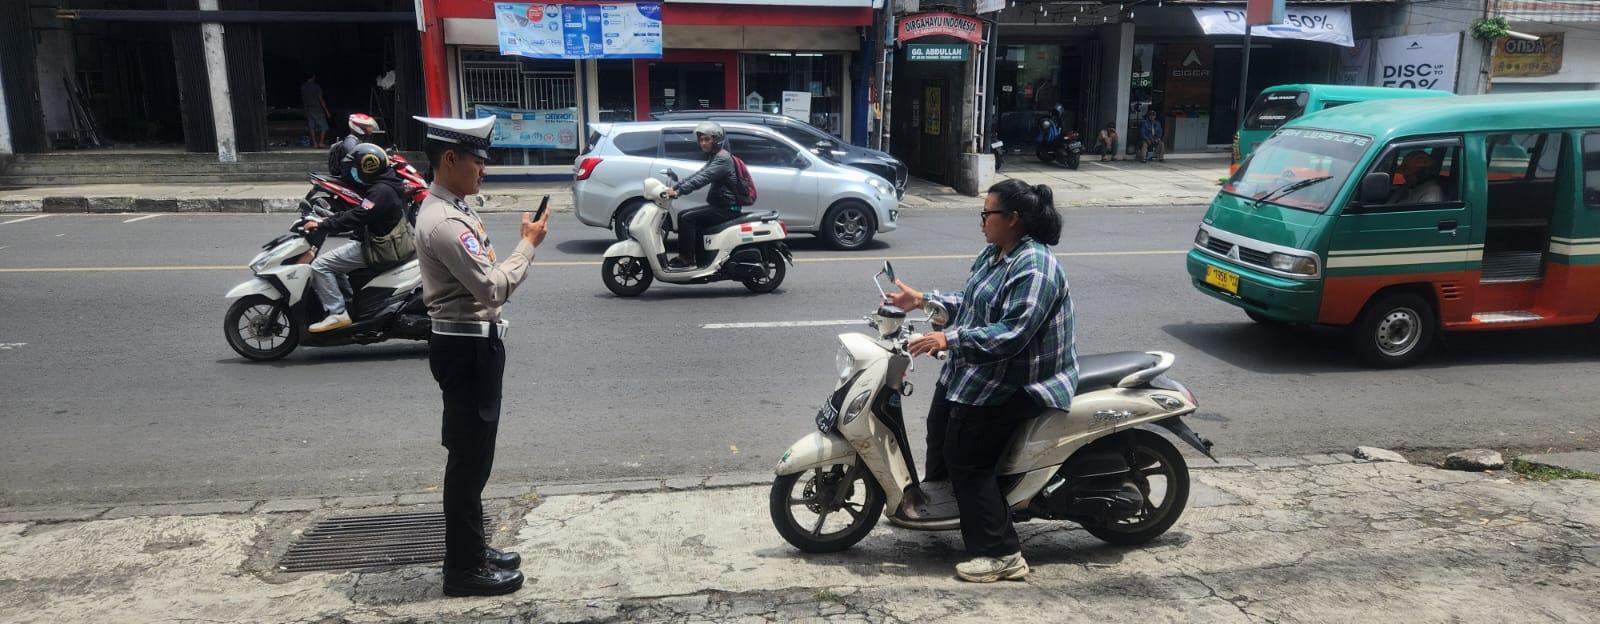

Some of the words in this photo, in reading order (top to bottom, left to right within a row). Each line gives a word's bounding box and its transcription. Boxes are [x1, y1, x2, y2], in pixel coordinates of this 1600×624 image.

[905, 16, 942, 32] DIRGAHAYU
[943, 16, 977, 32] INDONESIA
[1287, 14, 1334, 30] 50%
[925, 48, 962, 56] ABDULLAH
[1383, 63, 1433, 78] DISC
